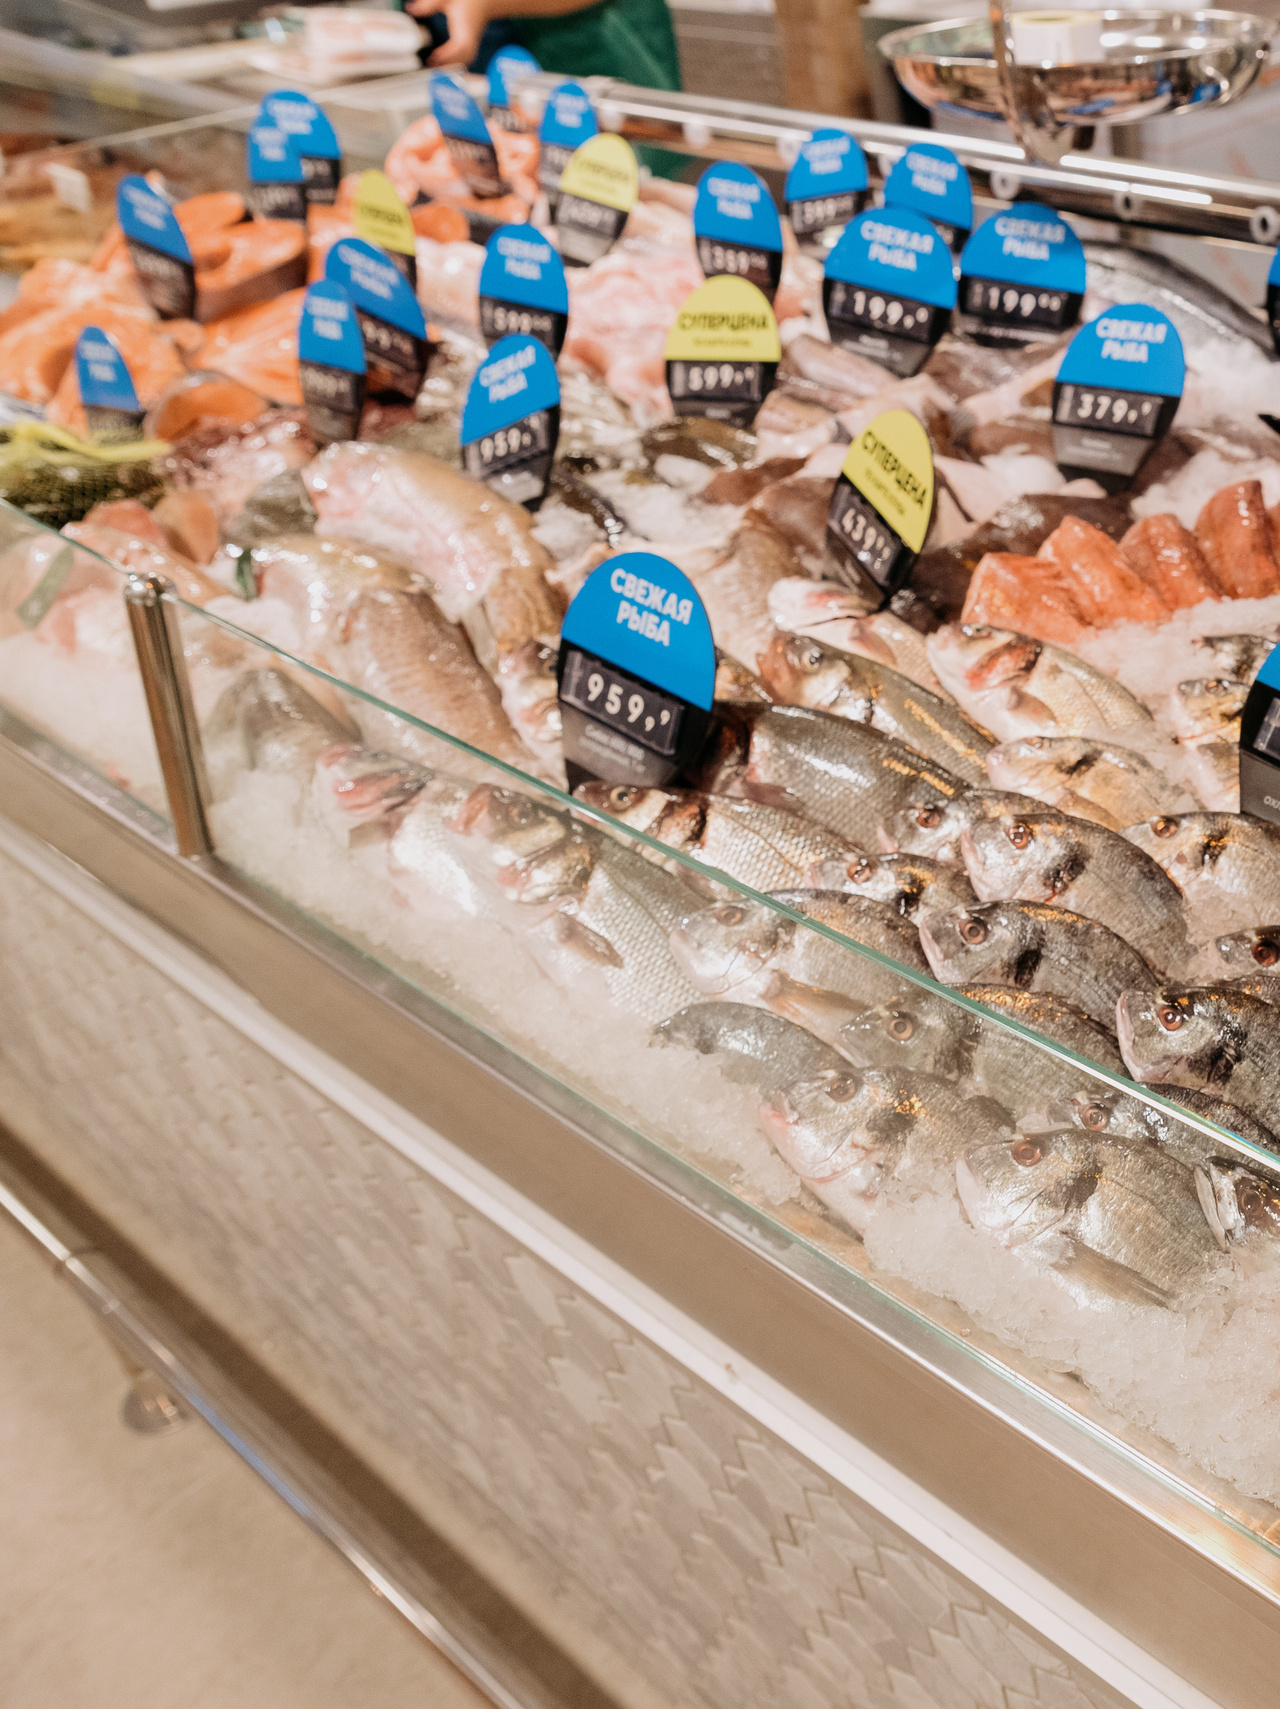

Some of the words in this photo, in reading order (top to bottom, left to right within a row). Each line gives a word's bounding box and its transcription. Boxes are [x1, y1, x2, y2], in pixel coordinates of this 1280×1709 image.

[860, 220, 936, 255] СВЕЖАЯ
[994, 217, 1067, 244] СВЕЖАЯ
[868, 242, 918, 272] РЫБА
[1002, 237, 1051, 261] РЫБА
[1096, 317, 1168, 344] СВЕЖАЯ
[1100, 339, 1150, 364] РЫБА
[610, 567, 695, 626] СВЕЖАЯ
[616, 600, 671, 647] РЫБА
